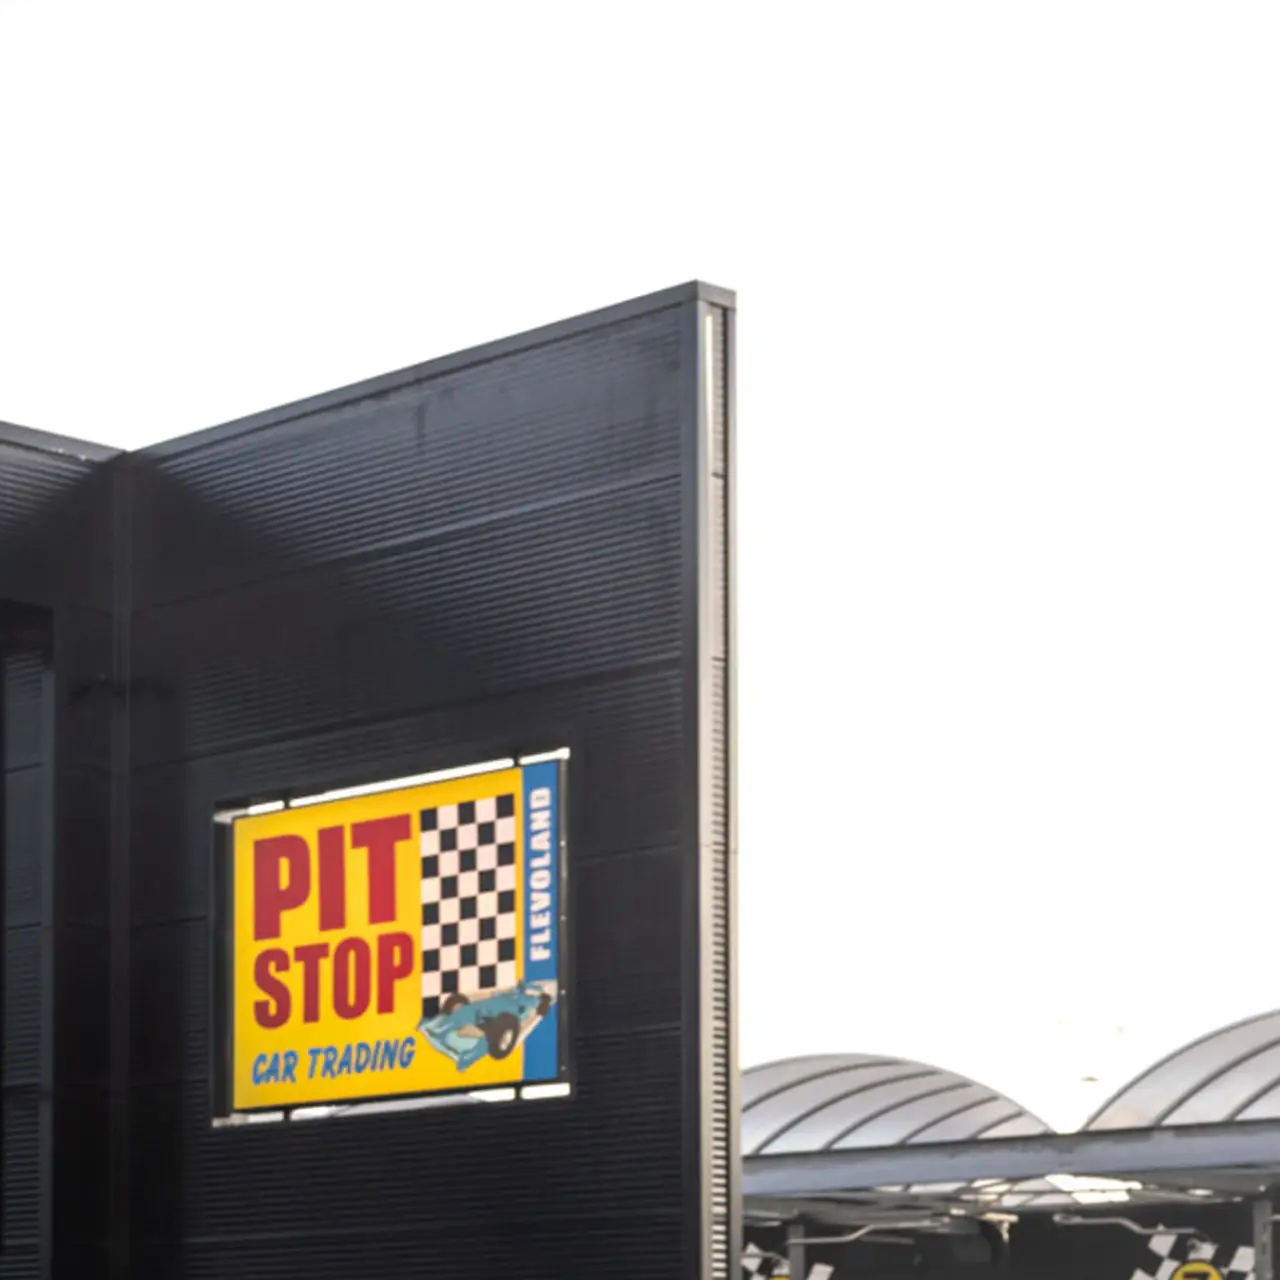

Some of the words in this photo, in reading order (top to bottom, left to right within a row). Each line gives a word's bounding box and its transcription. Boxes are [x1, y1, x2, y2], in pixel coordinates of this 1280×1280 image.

[253, 813, 412, 942] PIT
[529, 787, 552, 962] FLEVOLAND
[253, 931, 415, 1030] STOP
[252, 1049, 299, 1085] CAR
[307, 1036, 416, 1080] TRADING
